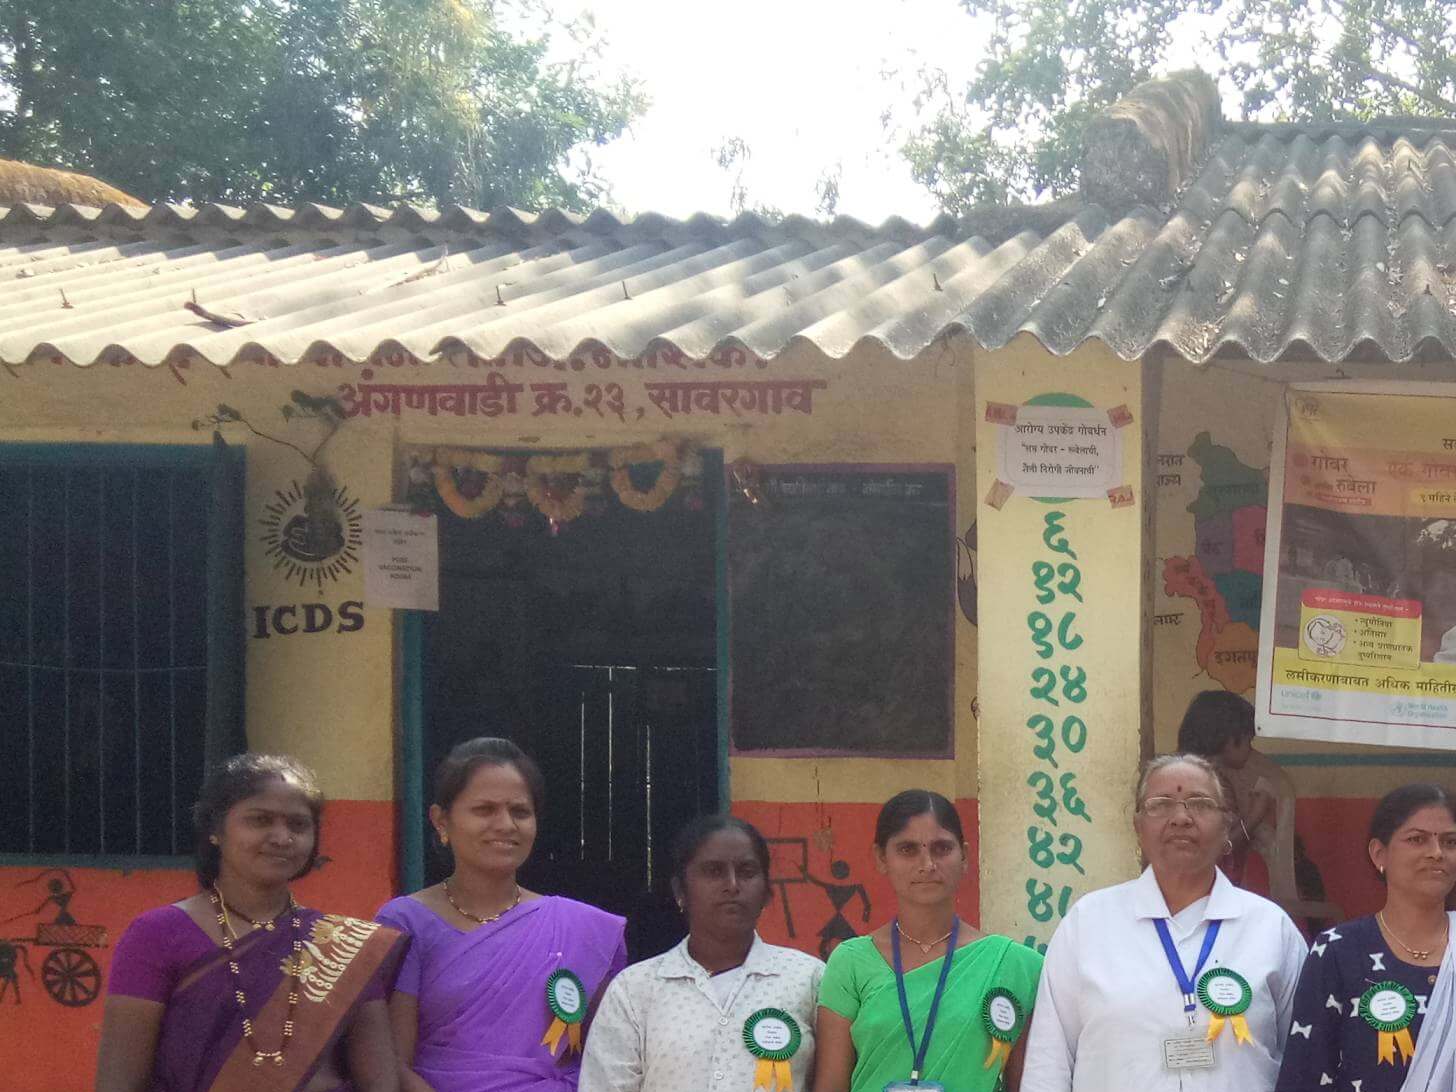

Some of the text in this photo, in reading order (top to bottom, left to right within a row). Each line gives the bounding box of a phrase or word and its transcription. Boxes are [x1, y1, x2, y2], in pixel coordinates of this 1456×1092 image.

[337, 369, 524, 418] अंगणवाडी
[644, 379, 828, 420] सावरगाव
[1015, 422, 1044, 434] आरोग्य
[1078, 424, 1107, 437] गोवर्धन
[1311, 449, 1350, 473] गोवर
[1042, 511, 1077, 560] ६
[1031, 560, 1084, 604] १२
[253, 600, 365, 639] ICDS
[1027, 610, 1084, 660] १८
[1029, 664, 1088, 707] २४
[1285, 670, 1370, 690] लसीकरणाबाबत
[1375, 677, 1411, 693] अधिक
[1026, 713, 1087, 769] ३०
[1027, 772, 1092, 827] ३६
[1027, 826, 1085, 875] ४२
